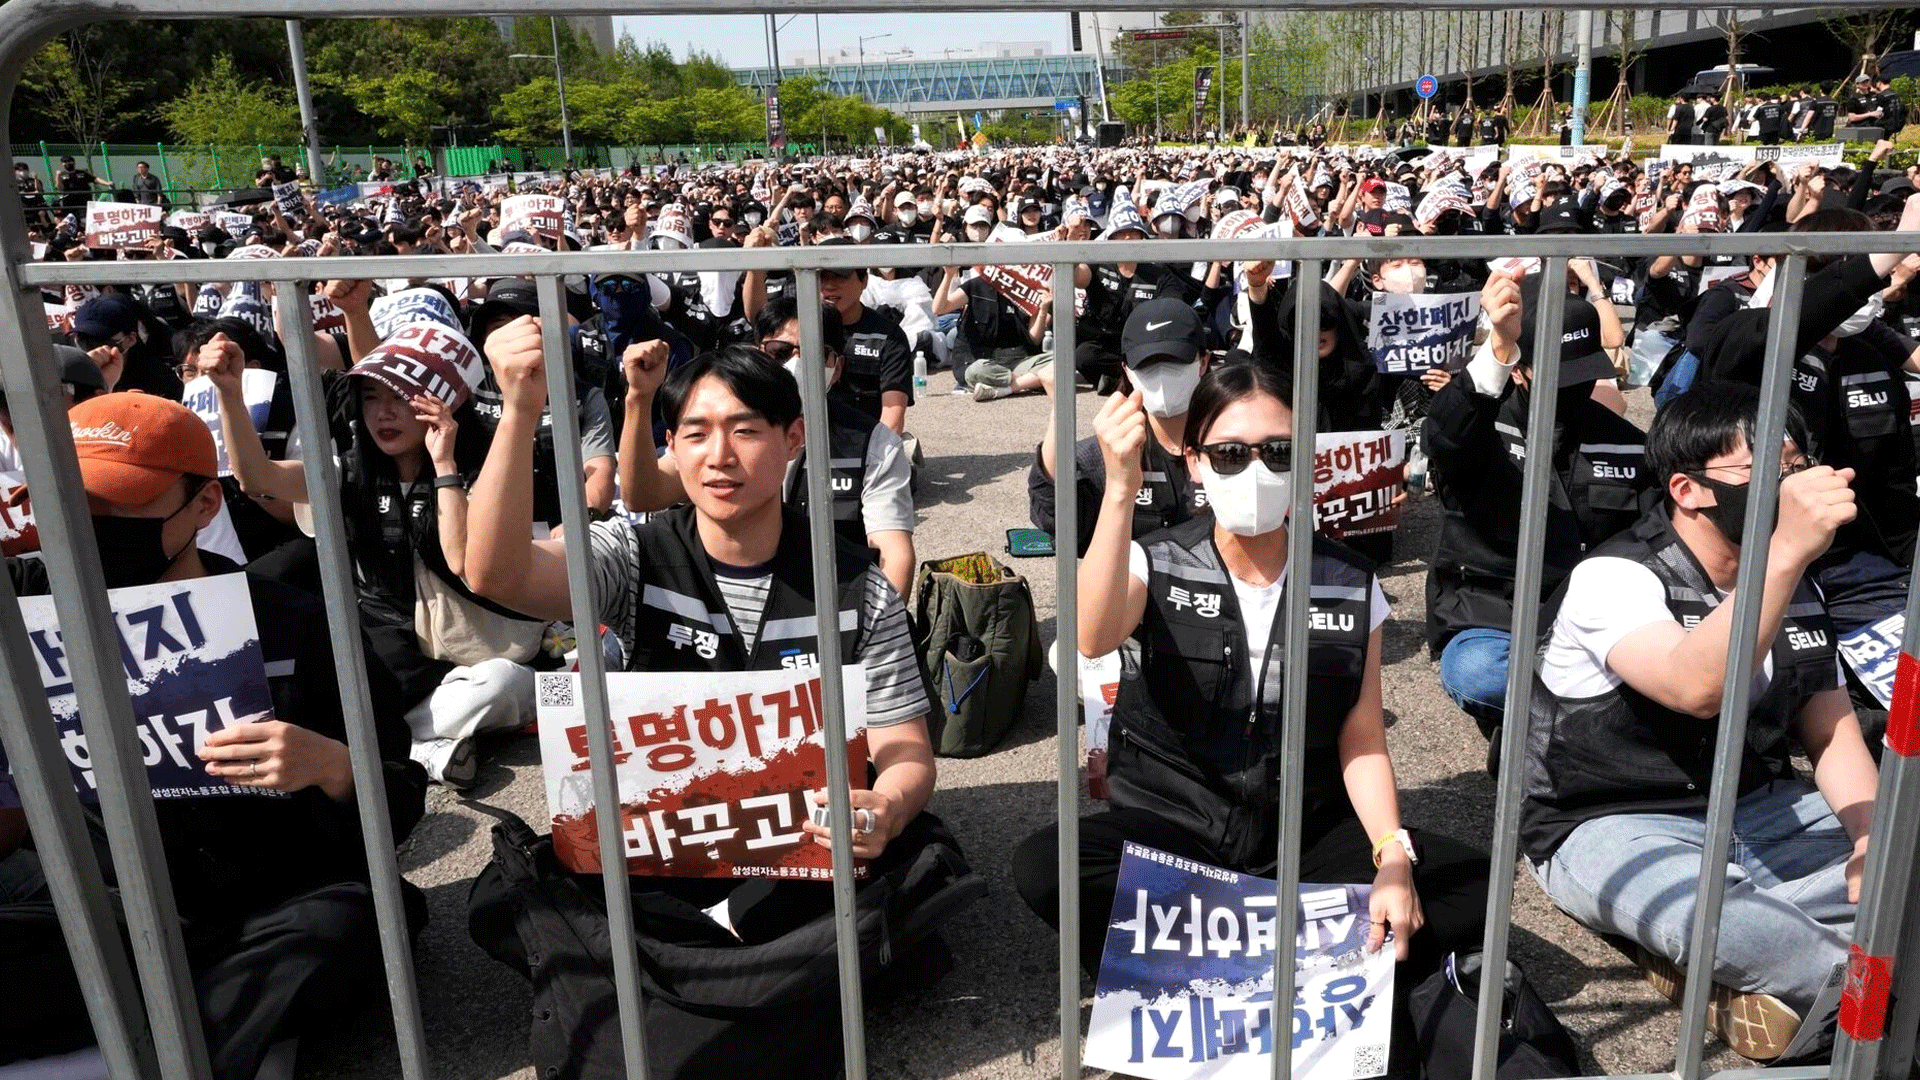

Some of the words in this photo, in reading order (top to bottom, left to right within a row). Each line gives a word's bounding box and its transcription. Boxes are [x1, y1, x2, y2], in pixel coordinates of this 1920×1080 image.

[92, 207, 152, 226] 투명하게
[1377, 296, 1471, 337] 상한폐지
[854, 347, 880, 357] SELU
[1383, 338, 1474, 373] 실현하자
[1848, 391, 1889, 408] SELU
[1593, 465, 1636, 480] SELU
[1167, 586, 1222, 618] 투쟁
[666, 622, 719, 660] 투쟁
[1790, 629, 1828, 650] SELU
[565, 678, 825, 772] 투명하게
[151, 785, 230, 798] 삼성전자노동조합
[1126, 844, 1174, 867] 공동투쟁본부
[732, 866, 808, 878] 삼성전자노동조합
[1174, 858, 1239, 885] 삼성전자노동조합
[1128, 974, 1375, 1063] 상한폐지
